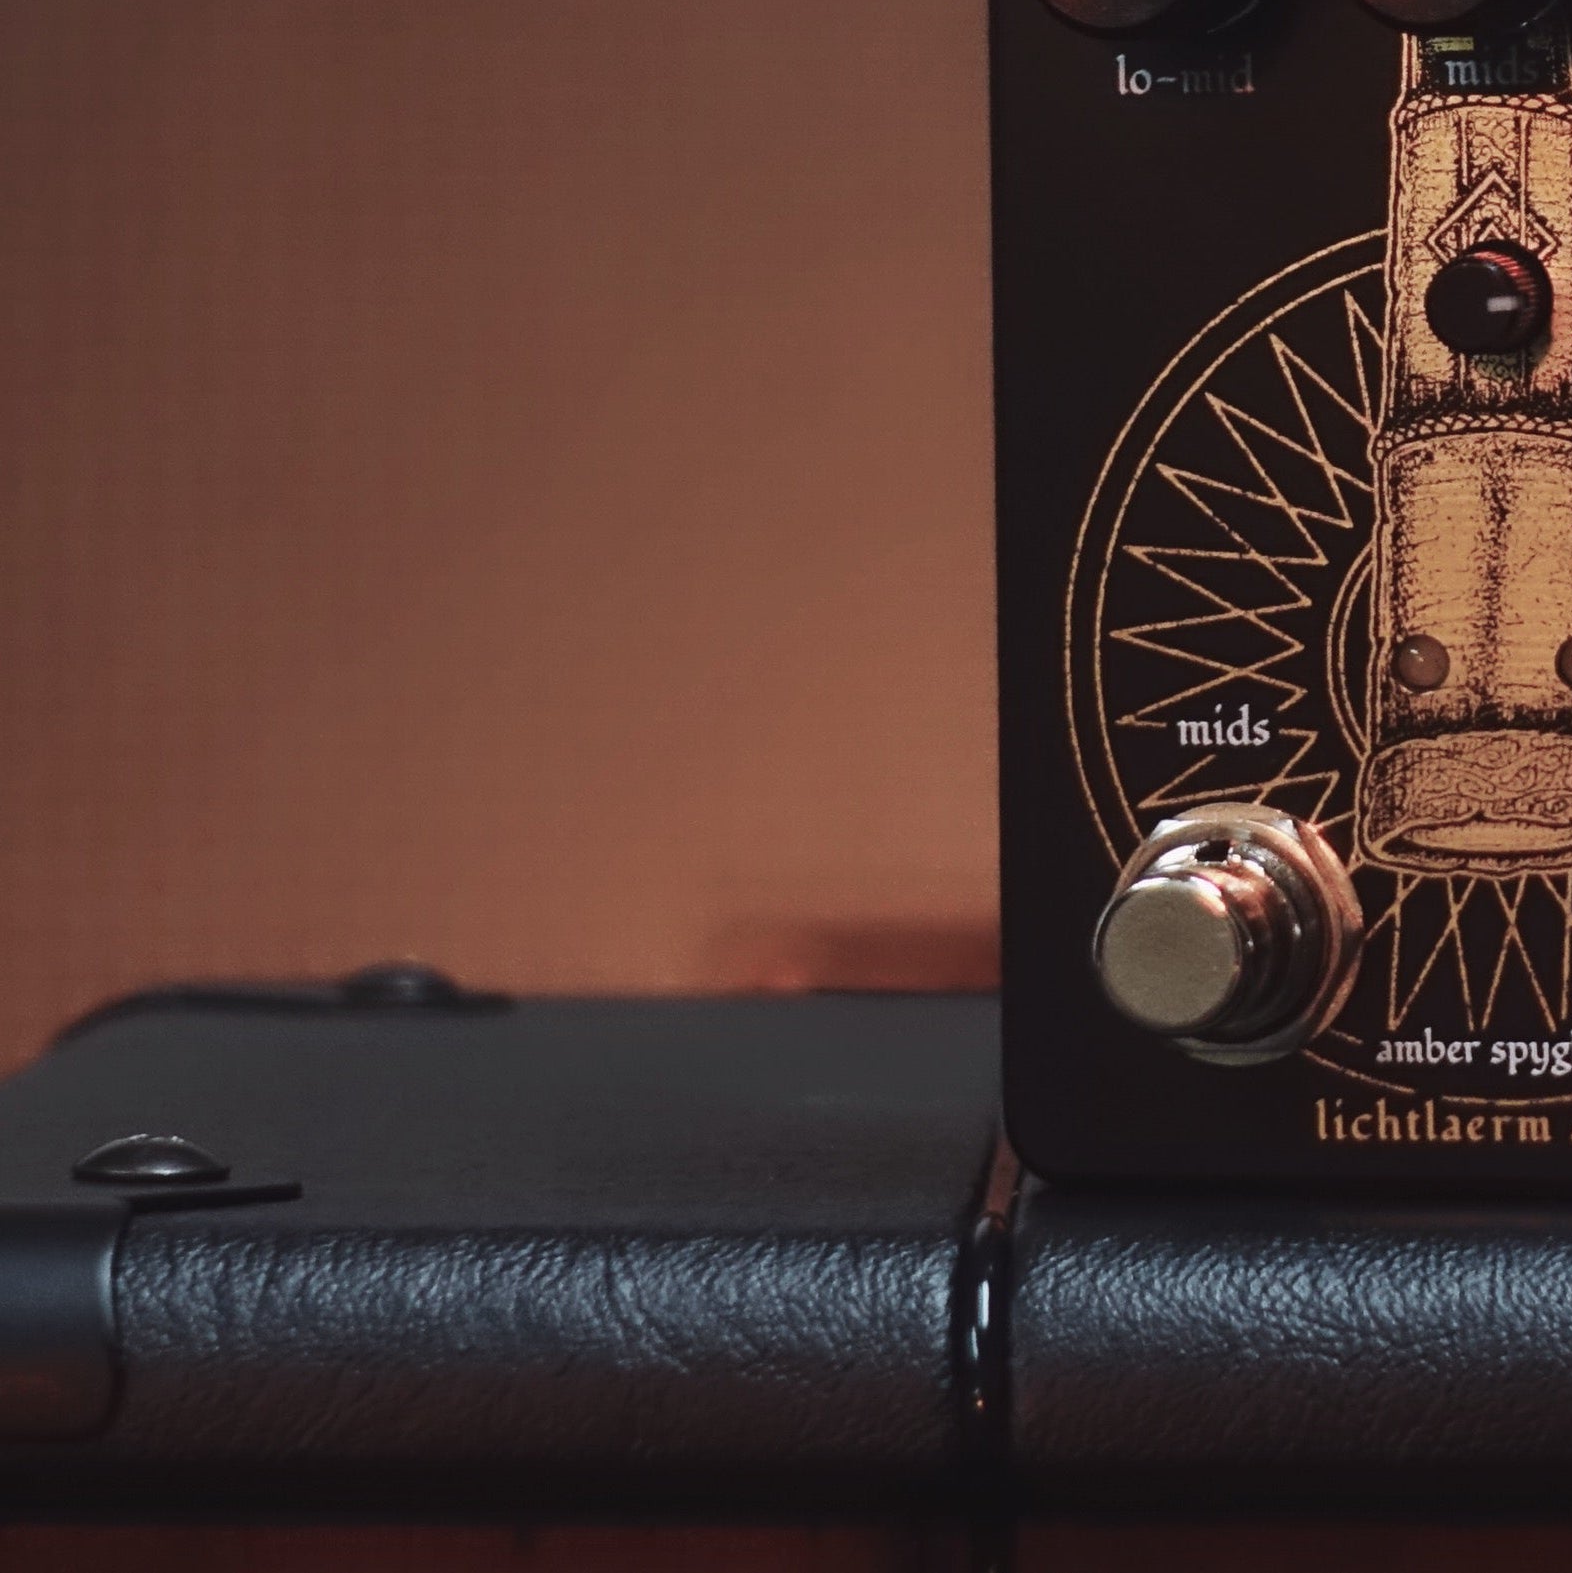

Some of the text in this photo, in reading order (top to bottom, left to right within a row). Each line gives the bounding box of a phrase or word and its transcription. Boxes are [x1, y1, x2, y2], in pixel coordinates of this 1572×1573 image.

[1115, 52, 1256, 96] lo-mid
[1443, 45, 1538, 86] mids
[1176, 702, 1272, 747] mids
[1375, 1027, 1481, 1065] amber
[1314, 1097, 1552, 1144] lichtlaerm
